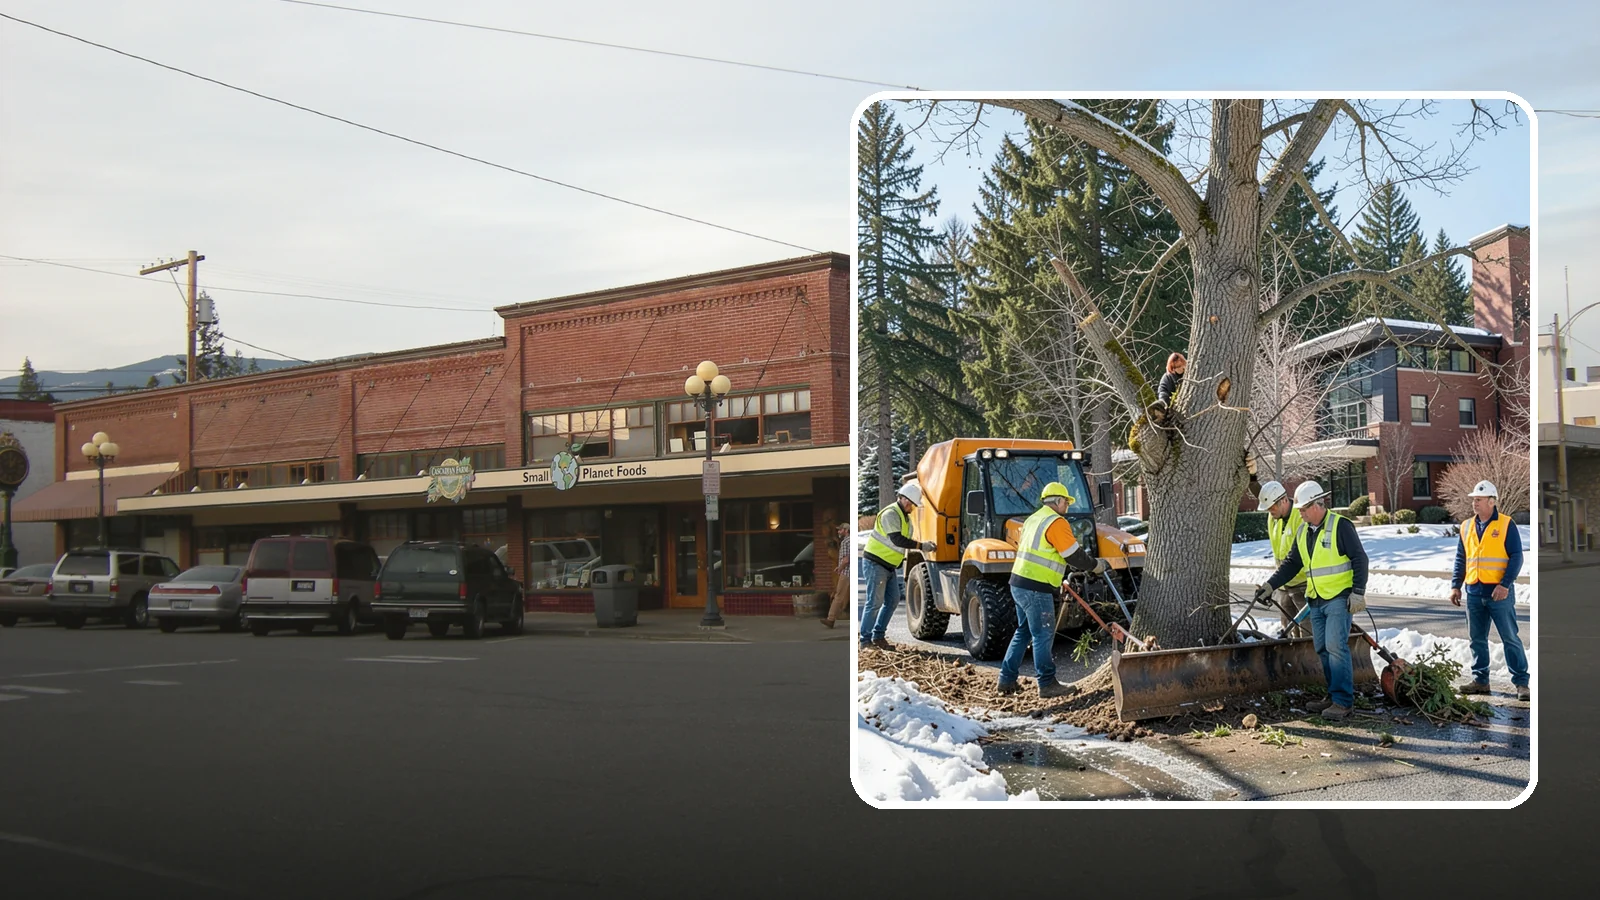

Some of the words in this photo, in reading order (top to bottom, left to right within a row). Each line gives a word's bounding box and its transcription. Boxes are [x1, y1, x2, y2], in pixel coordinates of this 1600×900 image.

[431, 466, 455, 476] CASCADIAN
[523, 471, 549, 483] Small
[583, 467, 614, 479] Planet
[617, 464, 647, 477] Foods
